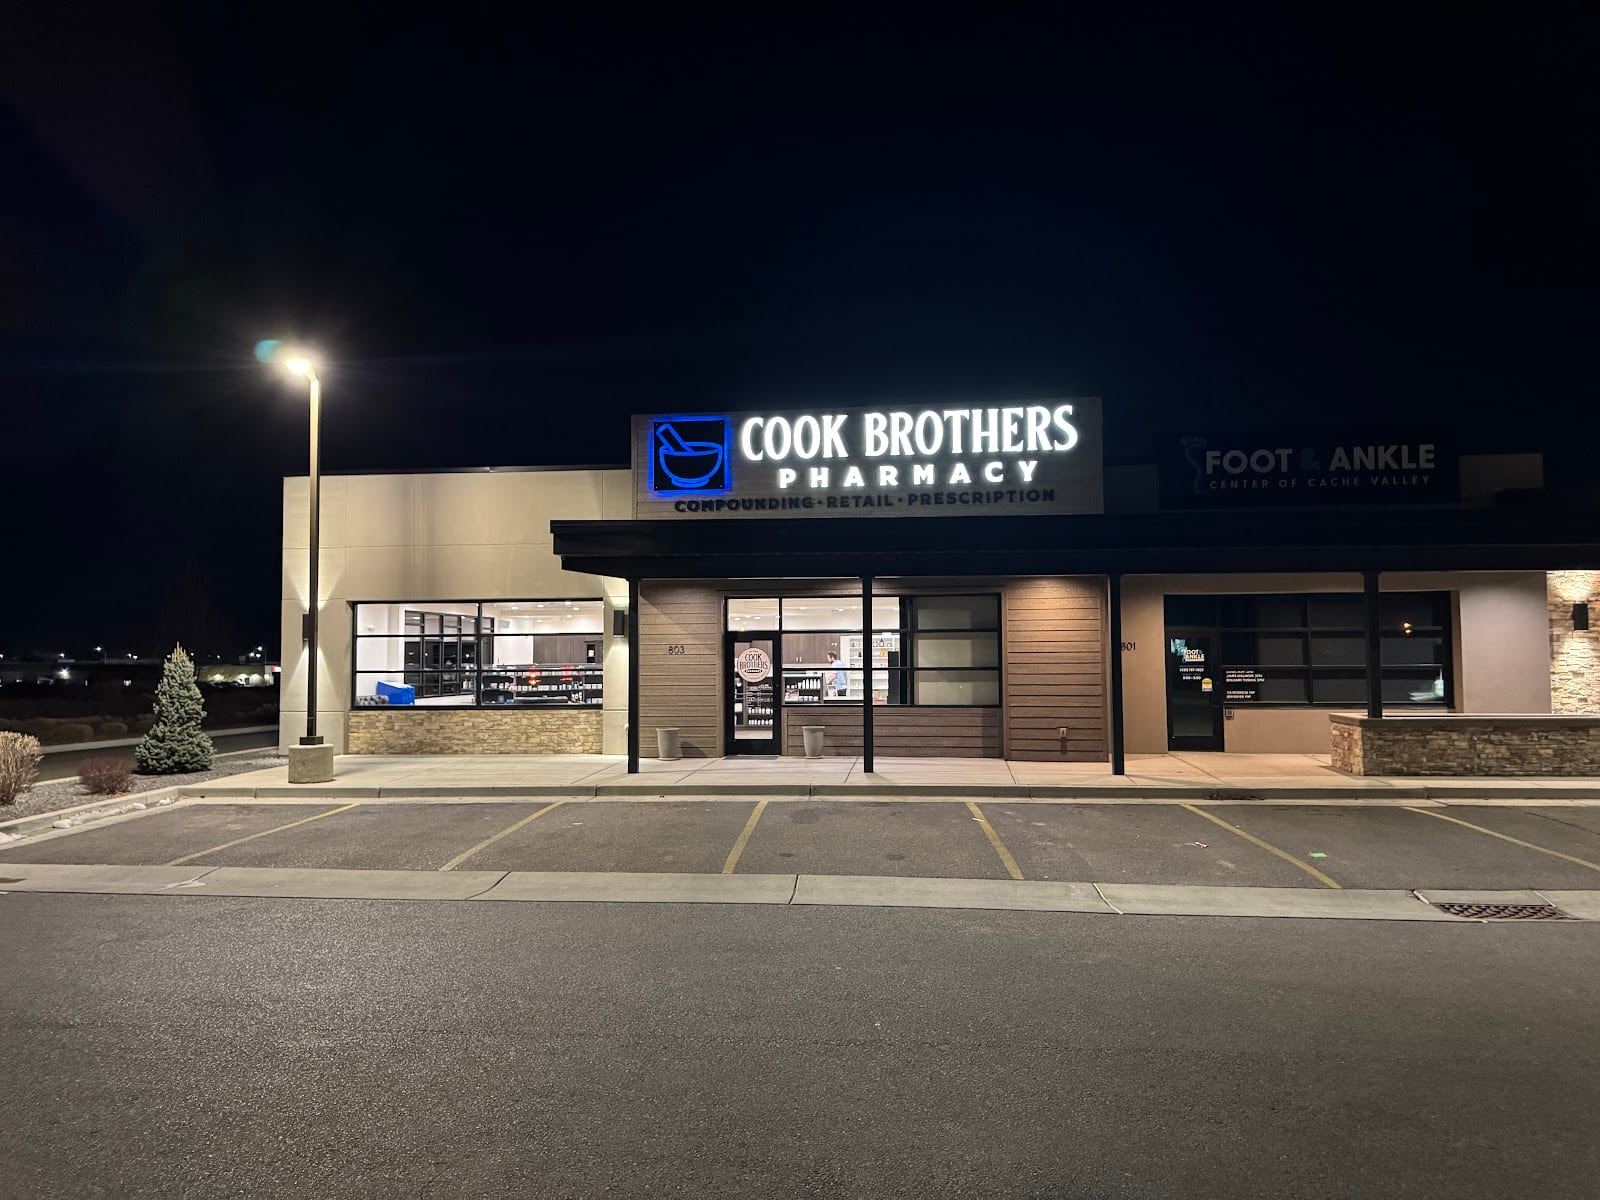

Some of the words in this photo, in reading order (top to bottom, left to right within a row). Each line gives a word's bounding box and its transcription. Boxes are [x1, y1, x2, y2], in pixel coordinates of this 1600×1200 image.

[741, 414, 848, 461] COOK
[864, 405, 1079, 457] BROTHERS
[1205, 448, 1293, 474] FOOT
[1300, 447, 1321, 471] &
[1329, 444, 1436, 471] ANKLE
[778, 460, 1040, 489] PHARMACY
[1209, 479, 1270, 490] CENTER
[1278, 478, 1297, 488] OF
[1307, 477, 1361, 487] CACHE
[1371, 475, 1430, 485] VALLEY
[674, 496, 813, 513] COMPOUNDING
[826, 494, 894, 508] RETAIL
[907, 489, 1056, 506] PRESCRIPTION
[668, 645, 685, 655] 803
[745, 653, 762, 661] COOK
